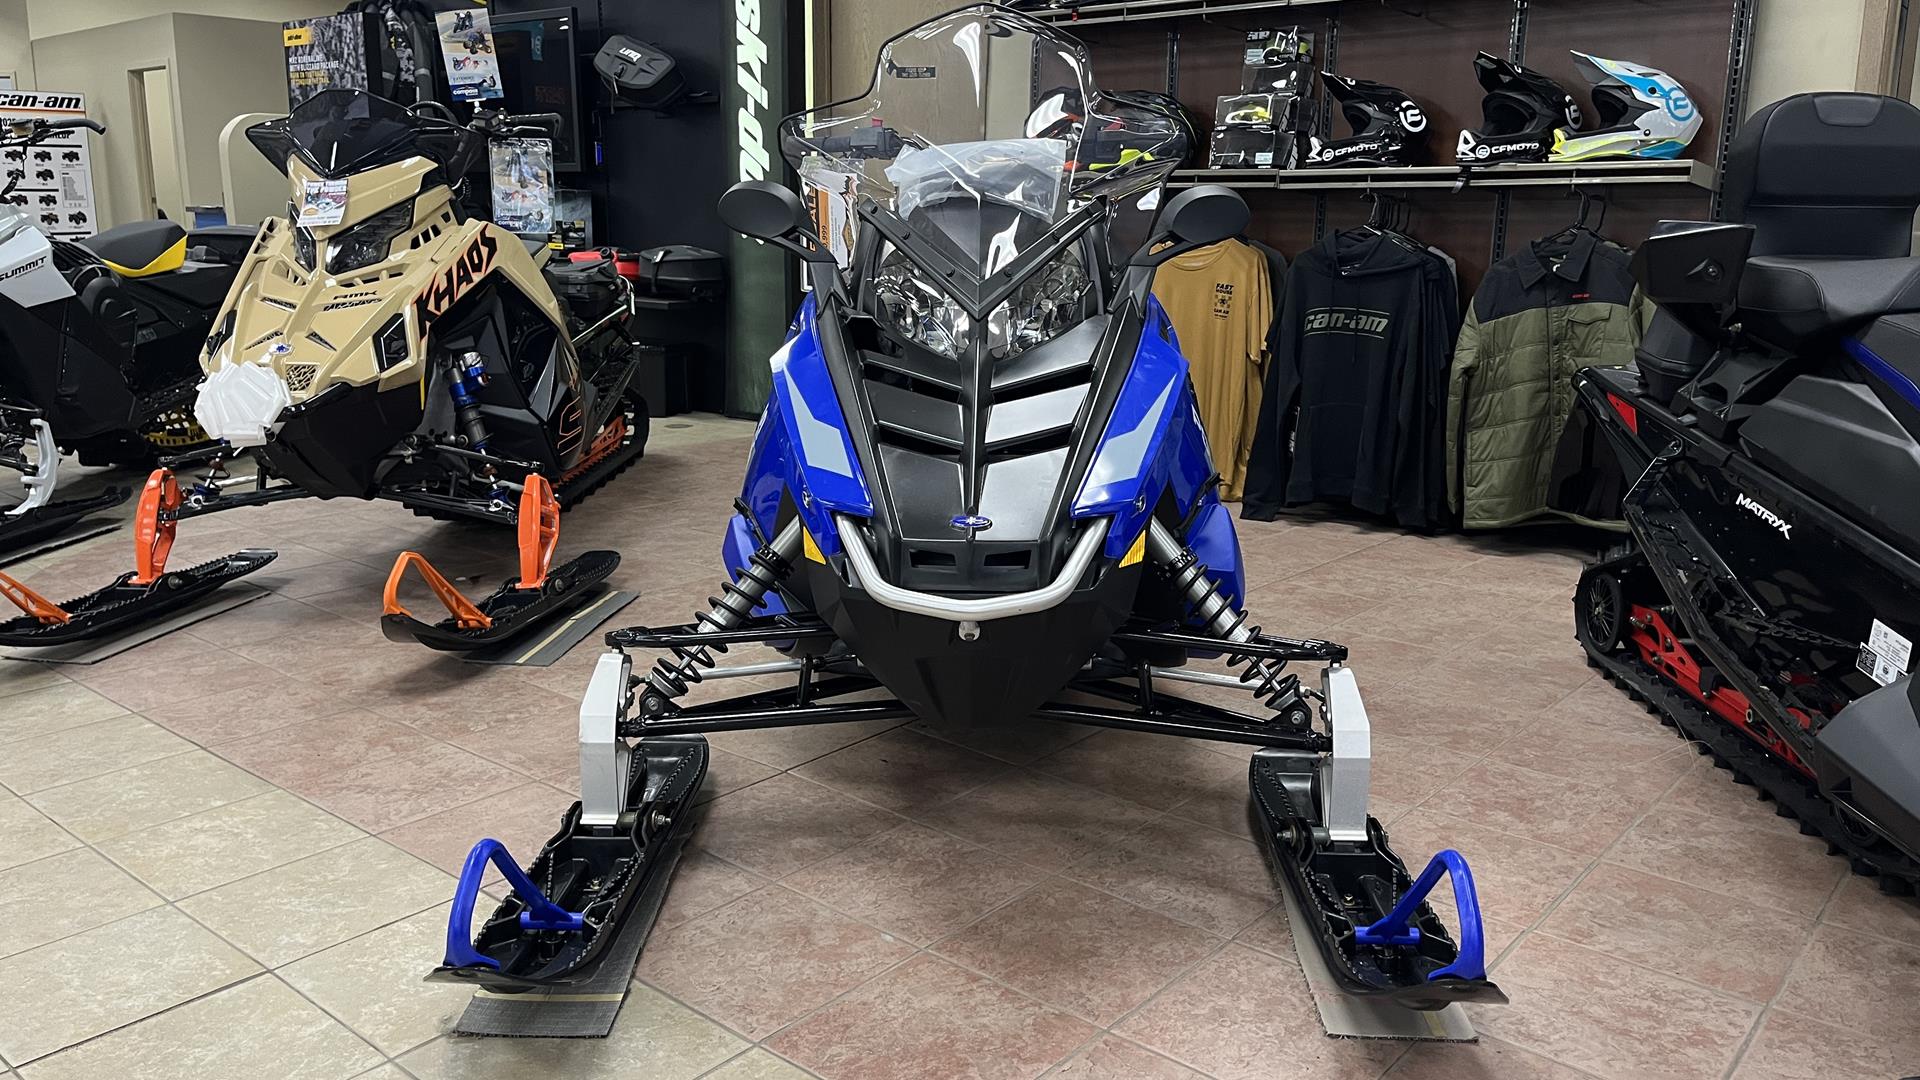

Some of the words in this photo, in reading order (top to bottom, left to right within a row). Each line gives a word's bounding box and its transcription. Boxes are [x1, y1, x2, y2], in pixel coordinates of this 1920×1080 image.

[735, 0, 771, 245] ski-do
[1335, 143, 1378, 156] CFMOTO
[1491, 143, 1539, 154] CFMOTO
[0, 256, 47, 280] SUMMIT
[412, 223, 498, 341] KHAOS
[1304, 313, 1388, 332] can-am
[1735, 493, 1792, 540] MATRYX
